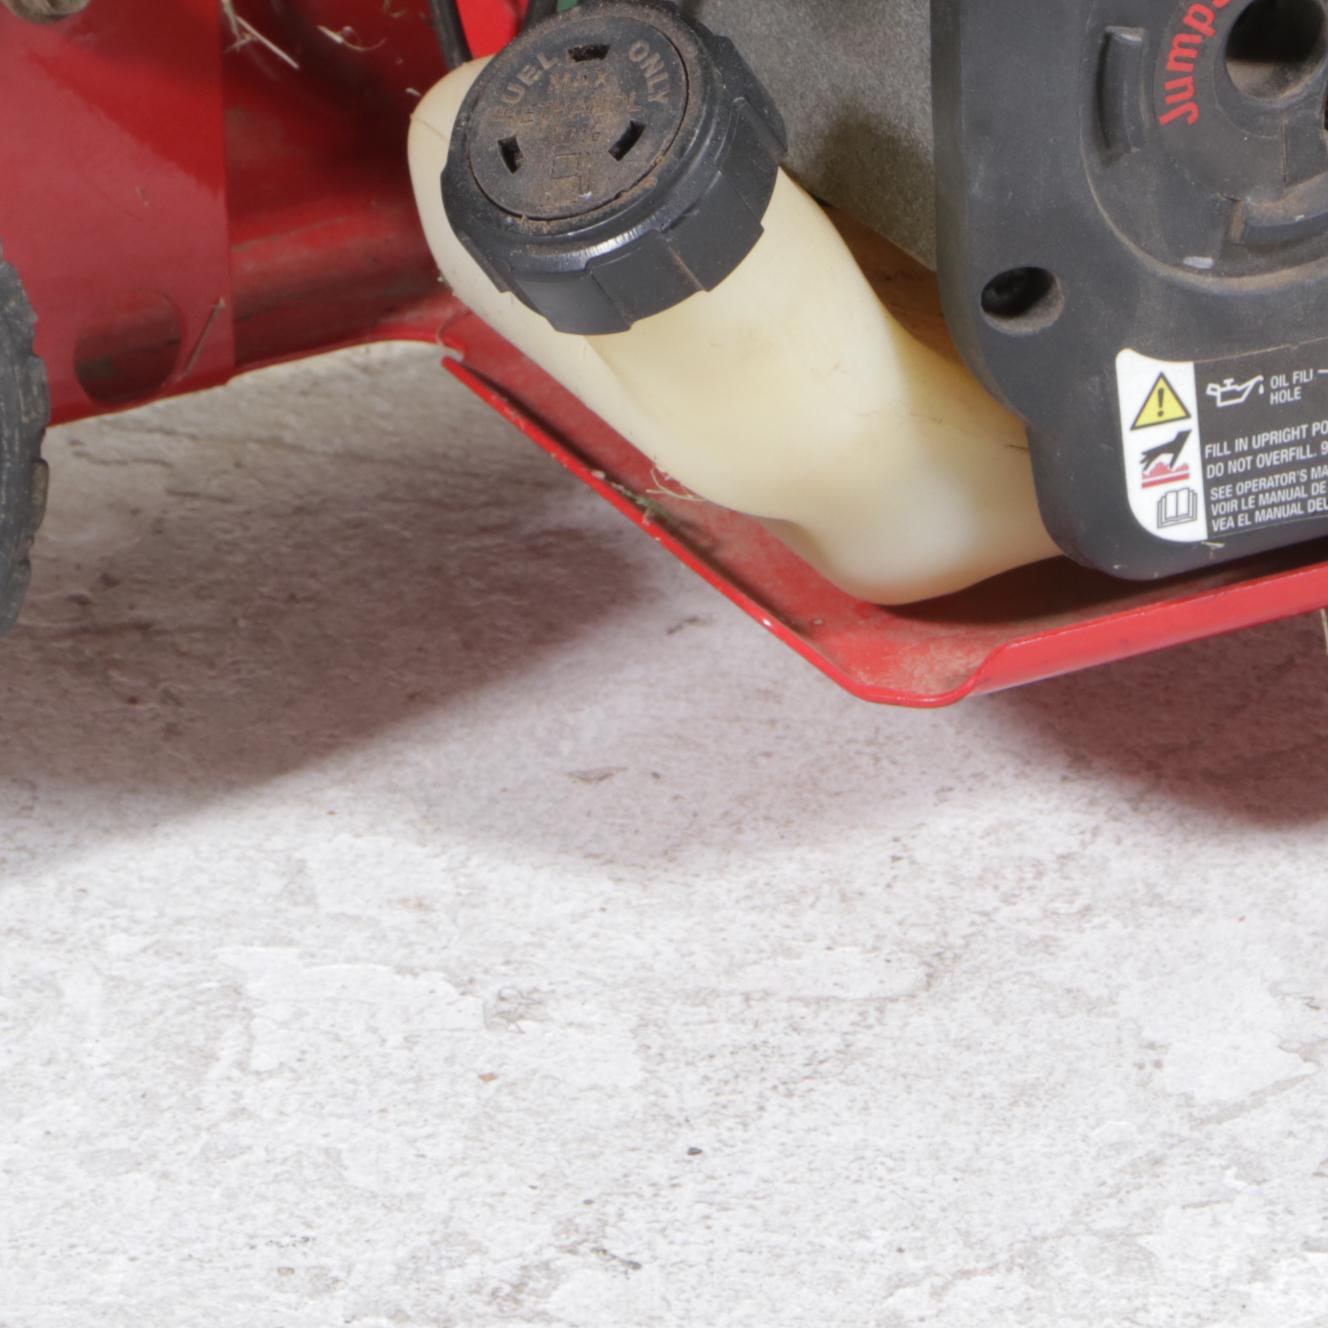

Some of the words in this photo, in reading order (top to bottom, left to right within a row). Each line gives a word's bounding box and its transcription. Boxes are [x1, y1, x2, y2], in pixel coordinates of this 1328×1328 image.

[629, 39, 672, 104] ONLY
[1270, 374, 1289, 390] OIL
[1270, 386, 1302, 405] HOLE
[1204, 443, 1231, 460] FILL
[1234, 438, 1249, 452] IN
[1252, 424, 1308, 449] UPRIGHT
[1206, 463, 1224, 479] DO
[1227, 456, 1253, 474] NOT
[1210, 484, 1233, 501] SEE
[1236, 468, 1308, 495] OPERATOR'S
[1211, 499, 1238, 517] VOIR
[1241, 495, 1255, 510] LE
[1258, 486, 1308, 507] MANUAL
[1311, 480, 1326, 495] DE
[1212, 516, 1235, 532] VEA
[1238, 512, 1251, 527] EL
[1255, 504, 1304, 525] MANUAL
